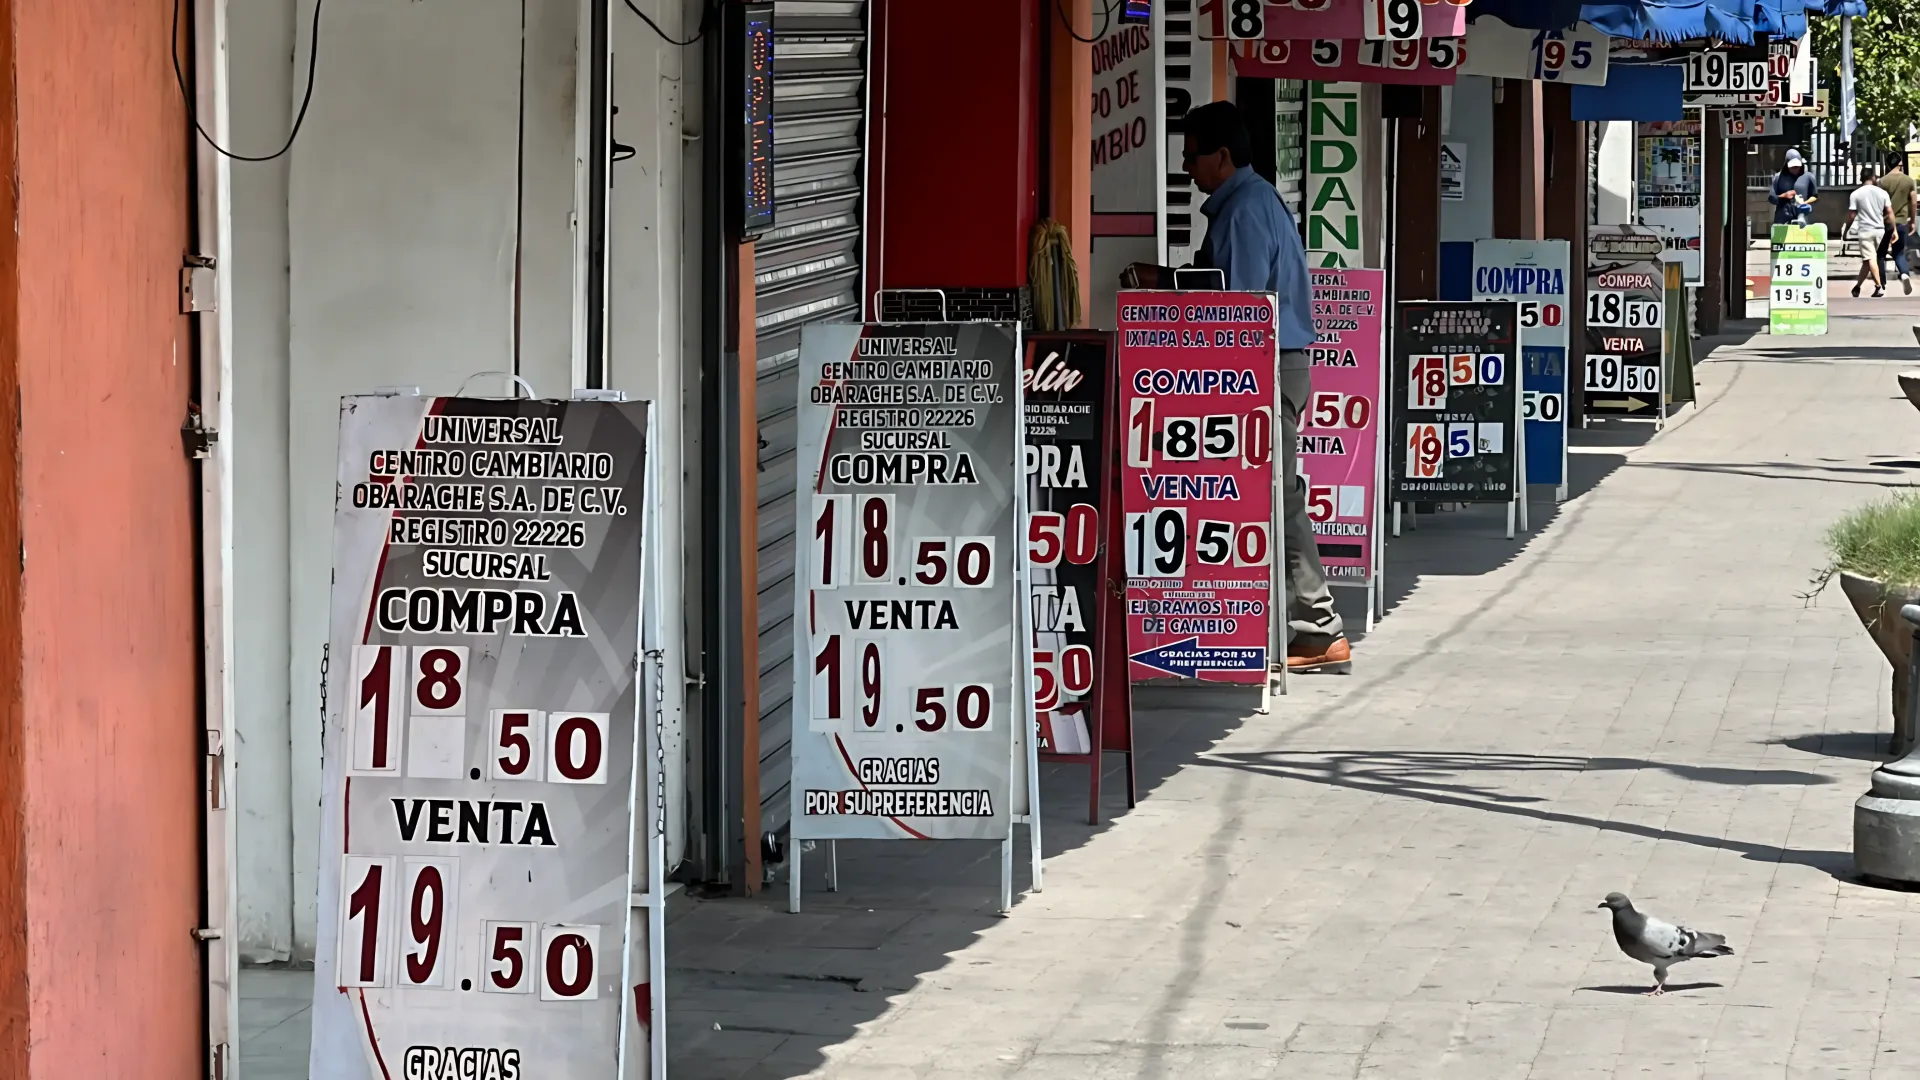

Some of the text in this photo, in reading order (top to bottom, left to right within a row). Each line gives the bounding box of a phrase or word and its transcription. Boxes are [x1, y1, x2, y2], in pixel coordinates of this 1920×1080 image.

[1116, 69, 1141, 110] DE
[1476, 266, 1565, 295] COMPRA
[1598, 273, 1653, 289] COMPRA
[1122, 305, 1271, 322] CENTRO CAMBIARIO
[1339, 305, 1352, 315] DE
[1520, 302, 1562, 328] 50
[858, 337, 958, 357] UNIVERSAL
[1125, 330, 1266, 347] IXTAPA S.A. DE C.V.
[1602, 337, 1645, 352] VENTA
[821, 361, 993, 380] CENTRO CAMBIARIO
[1133, 368, 1260, 395] COMPRA
[810, 385, 1004, 405] OBARACHE S.A. DE C.V.
[423, 416, 563, 445] UNIVERSAL
[837, 409, 976, 428] REGISTRO 22226
[861, 431, 952, 451] SUCURSAL
[369, 450, 613, 480] CENTRO CAMBIARIO
[830, 452, 980, 486] COMPRA
[352, 483, 627, 516] OBARACHE S.A. DE C.V.
[1140, 474, 1240, 500] VENTA
[390, 517, 585, 548] REGISTRO 22226
[423, 550, 551, 582] SUCURSAL
[377, 588, 588, 638] COMPRA
[844, 599, 961, 631] VENTA
[1226, 600, 1264, 616] TIPO
[1143, 618, 1237, 634] DE CAMBIO
[858, 757, 940, 785] GRACIAS
[804, 789, 994, 817] POR SU PREFERENCIA
[391, 798, 558, 848] VENTA
[403, 1046, 521, 1080] GRACIAS
